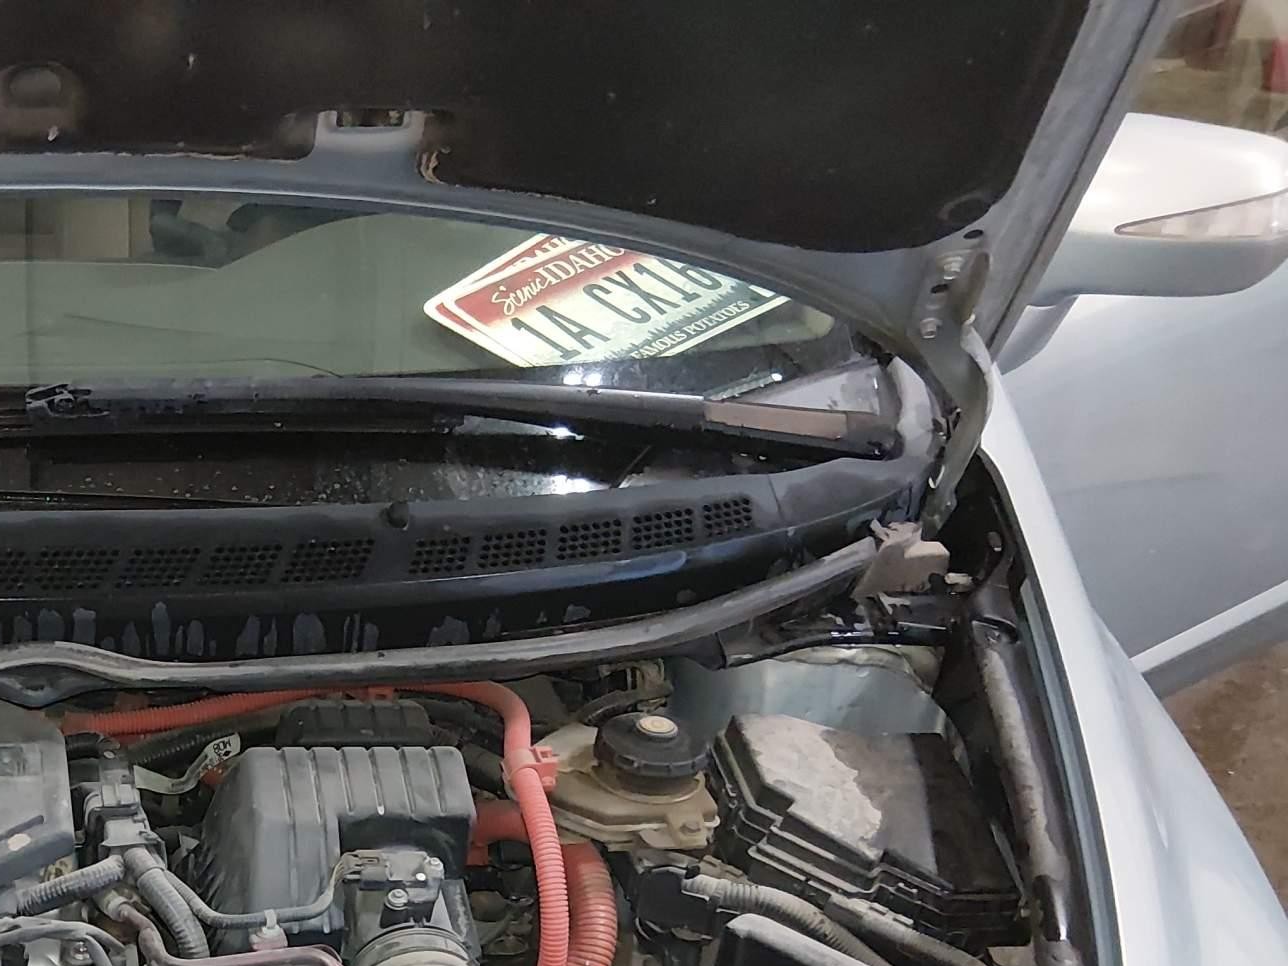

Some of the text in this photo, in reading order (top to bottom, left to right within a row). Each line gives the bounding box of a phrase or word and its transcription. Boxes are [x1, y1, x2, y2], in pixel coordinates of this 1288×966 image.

[491, 277, 548, 316] Scenic
[511, 304, 610, 361] 1A
[631, 300, 751, 360] FAMOUS POTATOES
